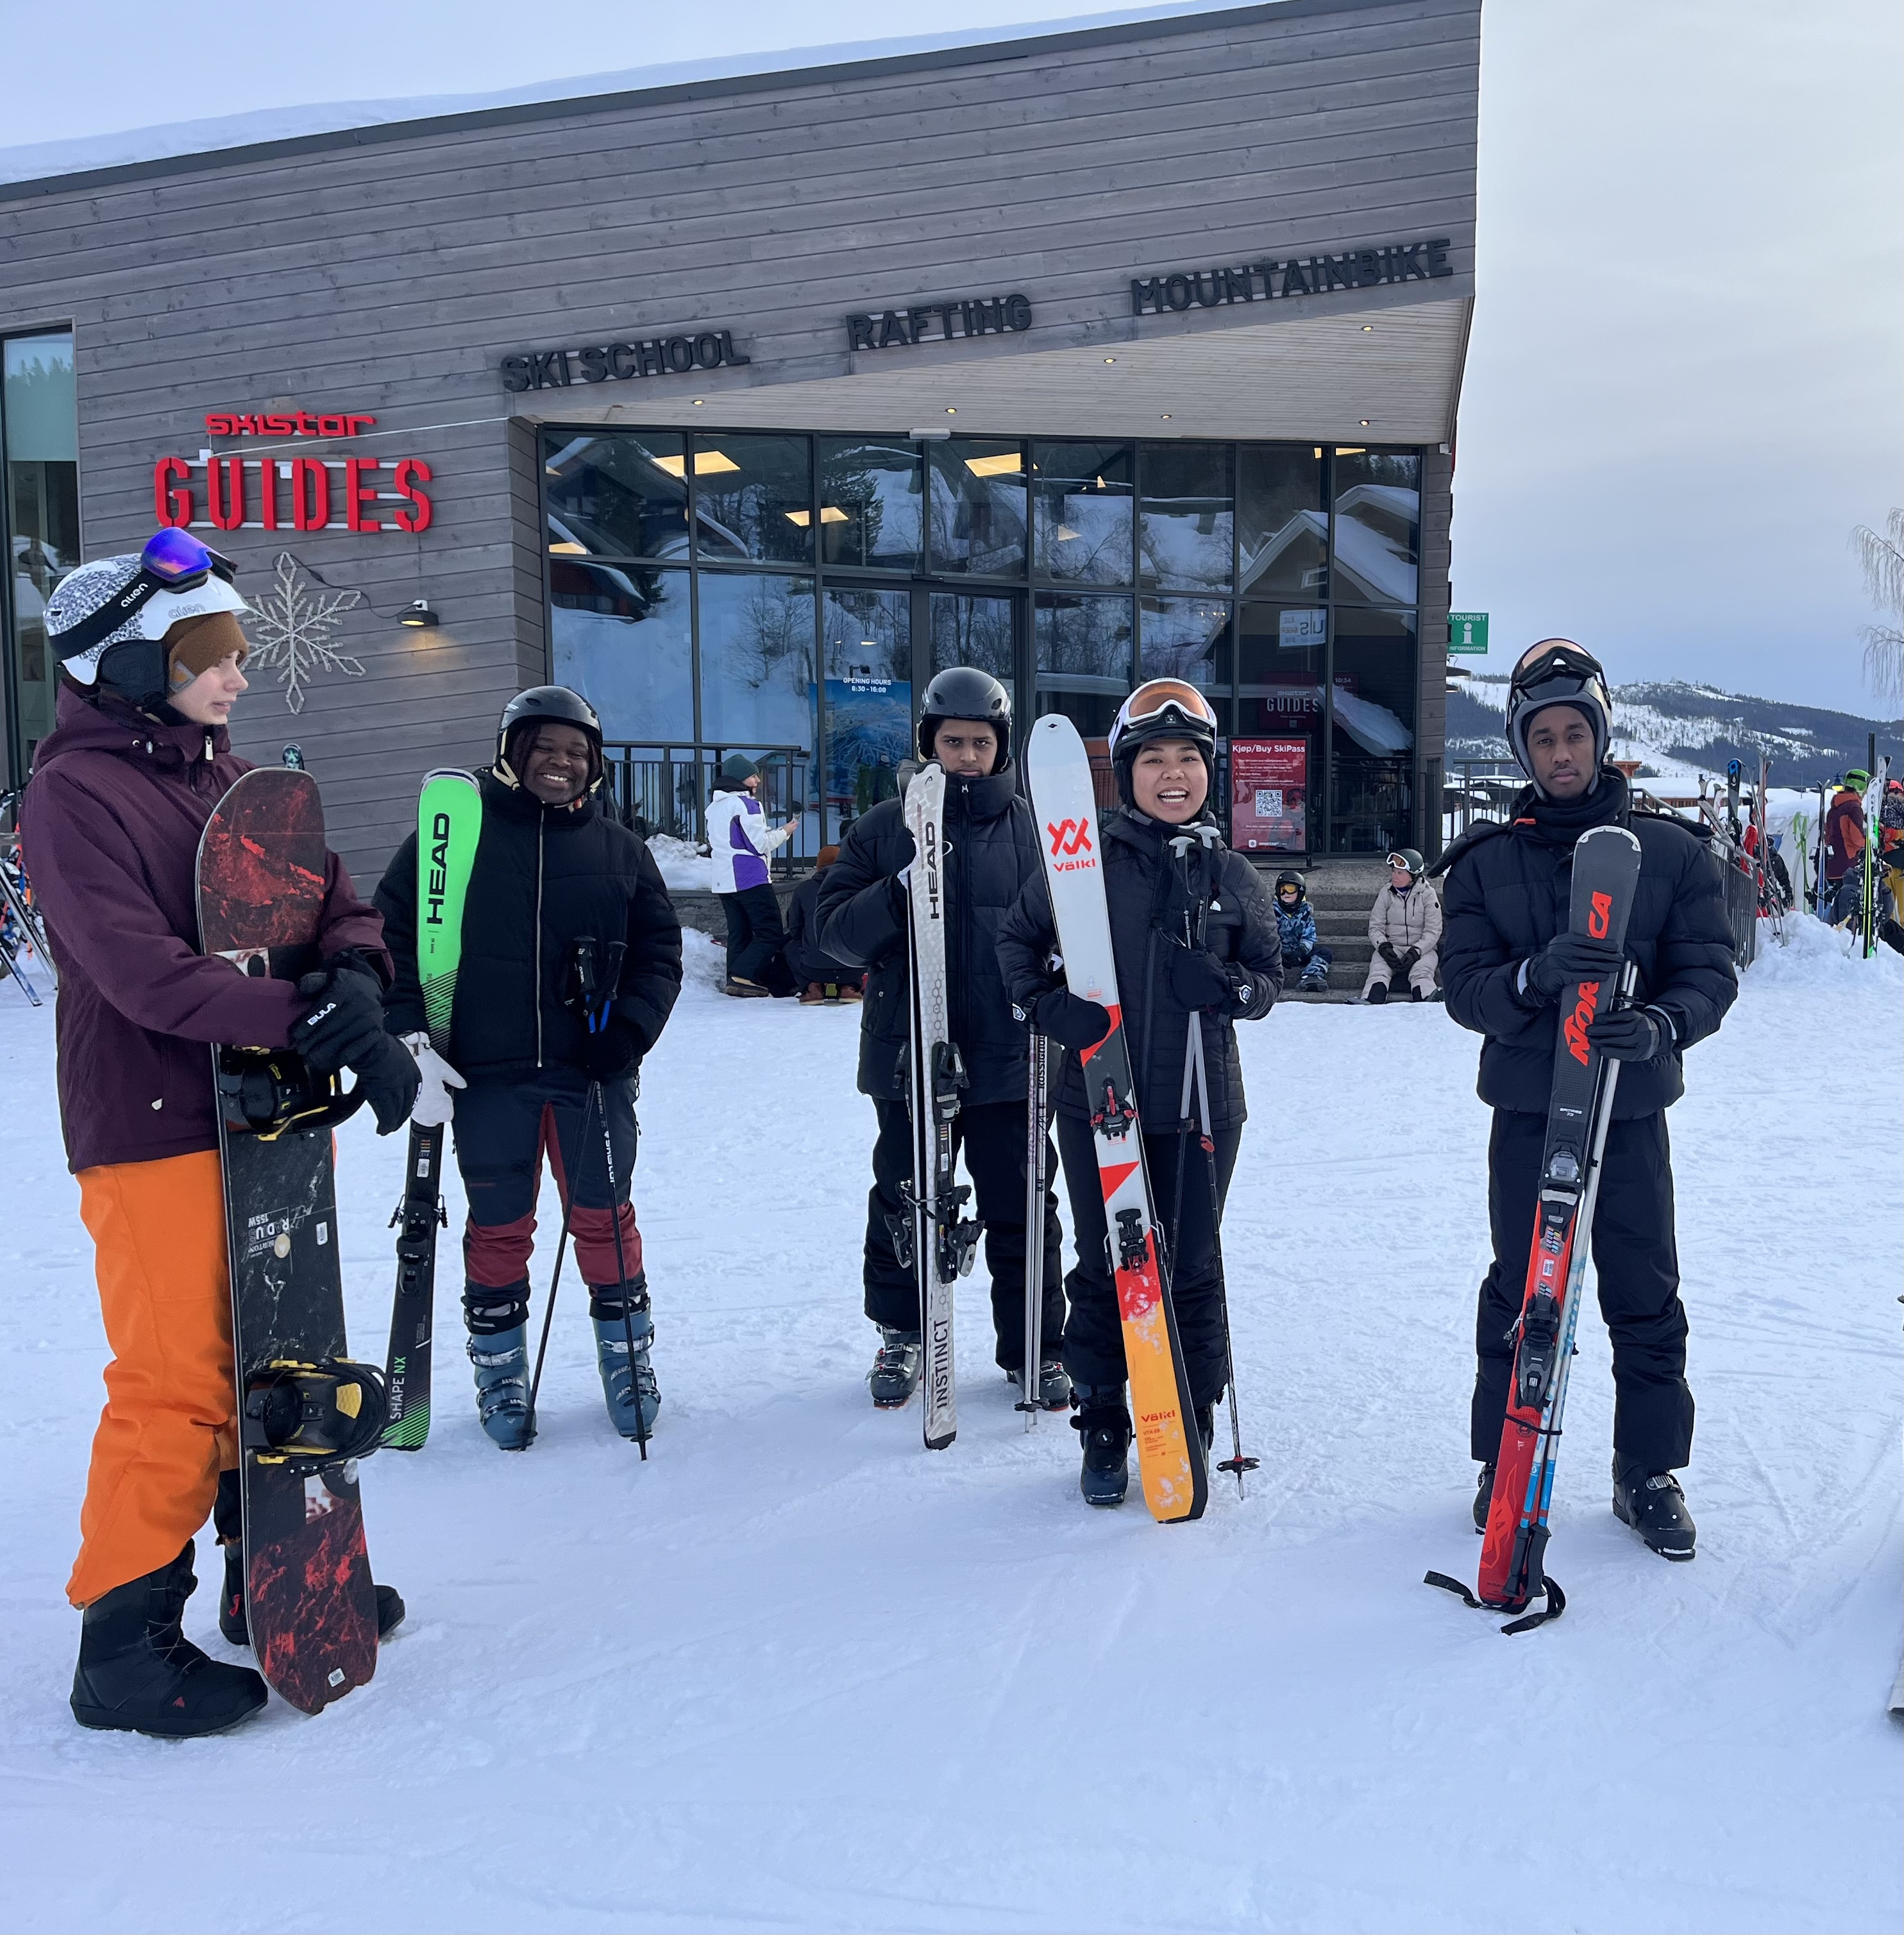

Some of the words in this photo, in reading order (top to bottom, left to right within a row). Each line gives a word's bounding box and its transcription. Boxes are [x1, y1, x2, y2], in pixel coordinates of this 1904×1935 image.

[1131, 239, 1454, 315] MOUNTAINBIKE
[846, 293, 1032, 351] RAFTING
[500, 351, 572, 393] SKI
[578, 330, 750, 383] SCHOOL
[154, 457, 434, 533] GUIDES
[1267, 697, 1318, 713] GUIDES
[1232, 744, 1272, 754] Kjøp/Buy
[1274, 744, 1306, 752] SkiPass
[426, 813, 450, 925] HEAD
[925, 821, 939, 920] HEAD
[1052, 858, 1096, 873] Völkl
[307, 1002, 337, 1026] BULA
[248, 1213, 269, 1228] 155W
[394, 1356, 407, 1374] NX
[933, 1319, 948, 1409] INSTINCT
[390, 1377, 405, 1419] SHAPE
